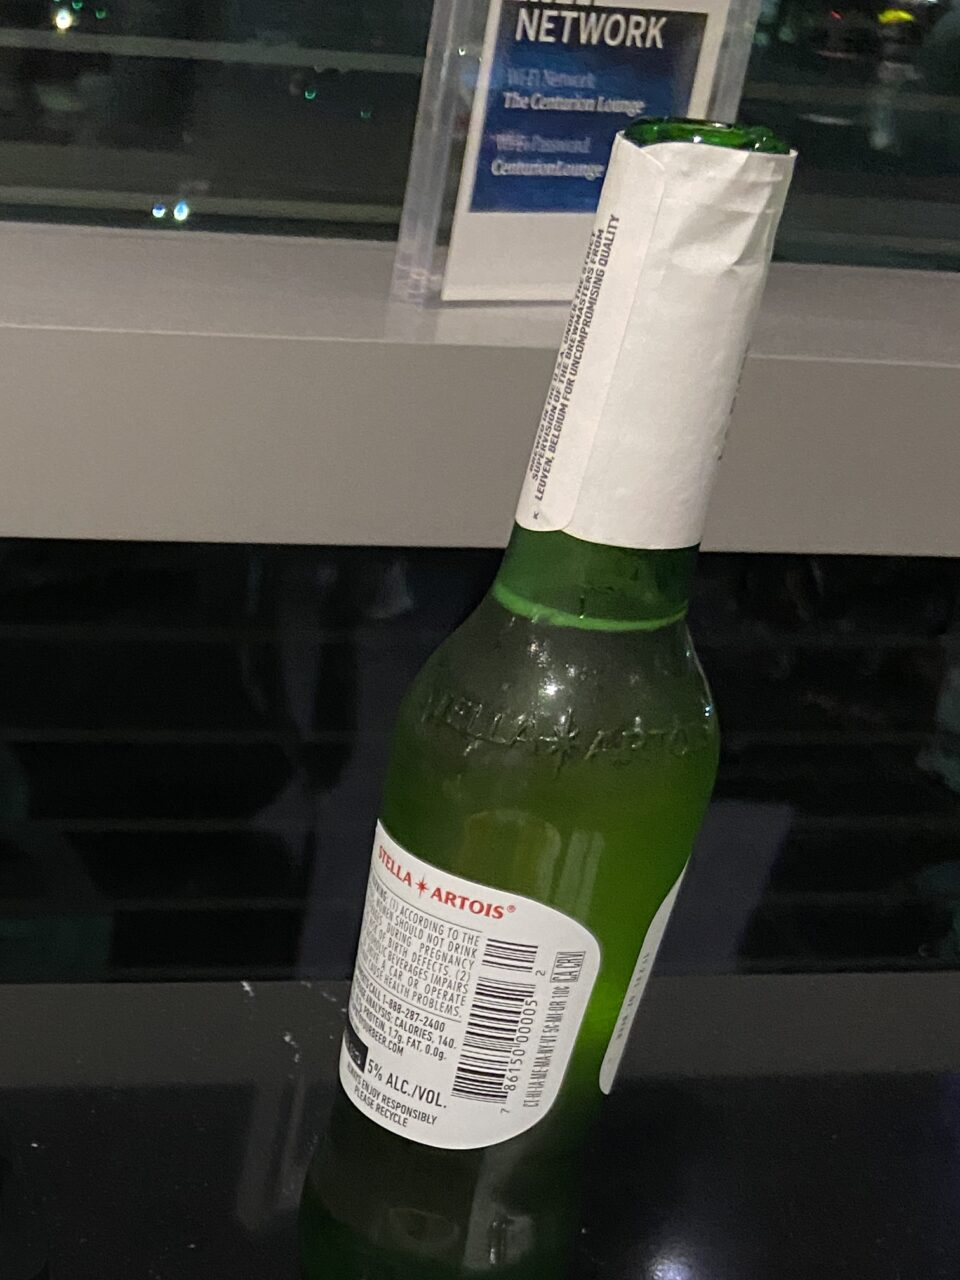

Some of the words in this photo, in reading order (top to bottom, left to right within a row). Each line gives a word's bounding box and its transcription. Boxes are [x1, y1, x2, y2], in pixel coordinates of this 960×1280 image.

[515, 8, 667, 49] NETWORK
[503, 92, 529, 109] The
[531, 93, 595, 112] Centurion
[597, 96, 646, 117] Lounge
[532, 406, 558, 481] SUPERVISION
[558, 361, 570, 385] THE
[565, 266, 595, 360] BREWMASTERS
[590, 229, 605, 265] FROM
[535, 455, 555, 501] LEUVEN,
[548, 402, 569, 454] BELGIUM
[562, 378, 576, 404] FOR
[569, 268, 606, 376] UNCOMPROMISING
[598, 214, 620, 267] QUALITY
[378, 845, 413, 888] STELLA
[386, 921, 413, 948] DURING
[419, 942, 476, 971] PREGNANCY
[394, 914, 425, 940] SHOULD
[427, 932, 445, 949] NOT
[447, 941, 478, 960] DRINK
[399, 905, 444, 936] ACCORDING
[447, 926, 459, 941] TO
[462, 932, 481, 947] THE
[387, 937, 408, 958] BIRTH
[411, 952, 451, 978] DEFECTS.
[455, 969, 471, 984] (2)
[387, 950, 429, 981] BEVERAGES
[430, 973, 469, 995] IMPAIRS
[366, 994, 394, 1023] ANALYSIS:
[368, 982, 381, 1002] CALL
[382, 994, 446, 1033] 1-888-287-2400
[384, 976, 410, 999] HEALTH
[411, 990, 462, 1018] PROBLEMS.
[388, 965, 404, 980] CAR
[407, 976, 419, 990] OR
[424, 983, 467, 1007] OPERATE
[503, 1048, 526, 1092] 86150
[515, 999, 538, 1044] 00005
[361, 1079, 381, 1100] ENJOY
[381, 1094, 438, 1125] RESPONSIBLY
[367, 1058, 383, 1081] 5%
[385, 1072, 447, 1109] ALC./VOL.
[354, 1085, 374, 1109] PLEASE
[375, 1103, 409, 1128] RECYCLE
